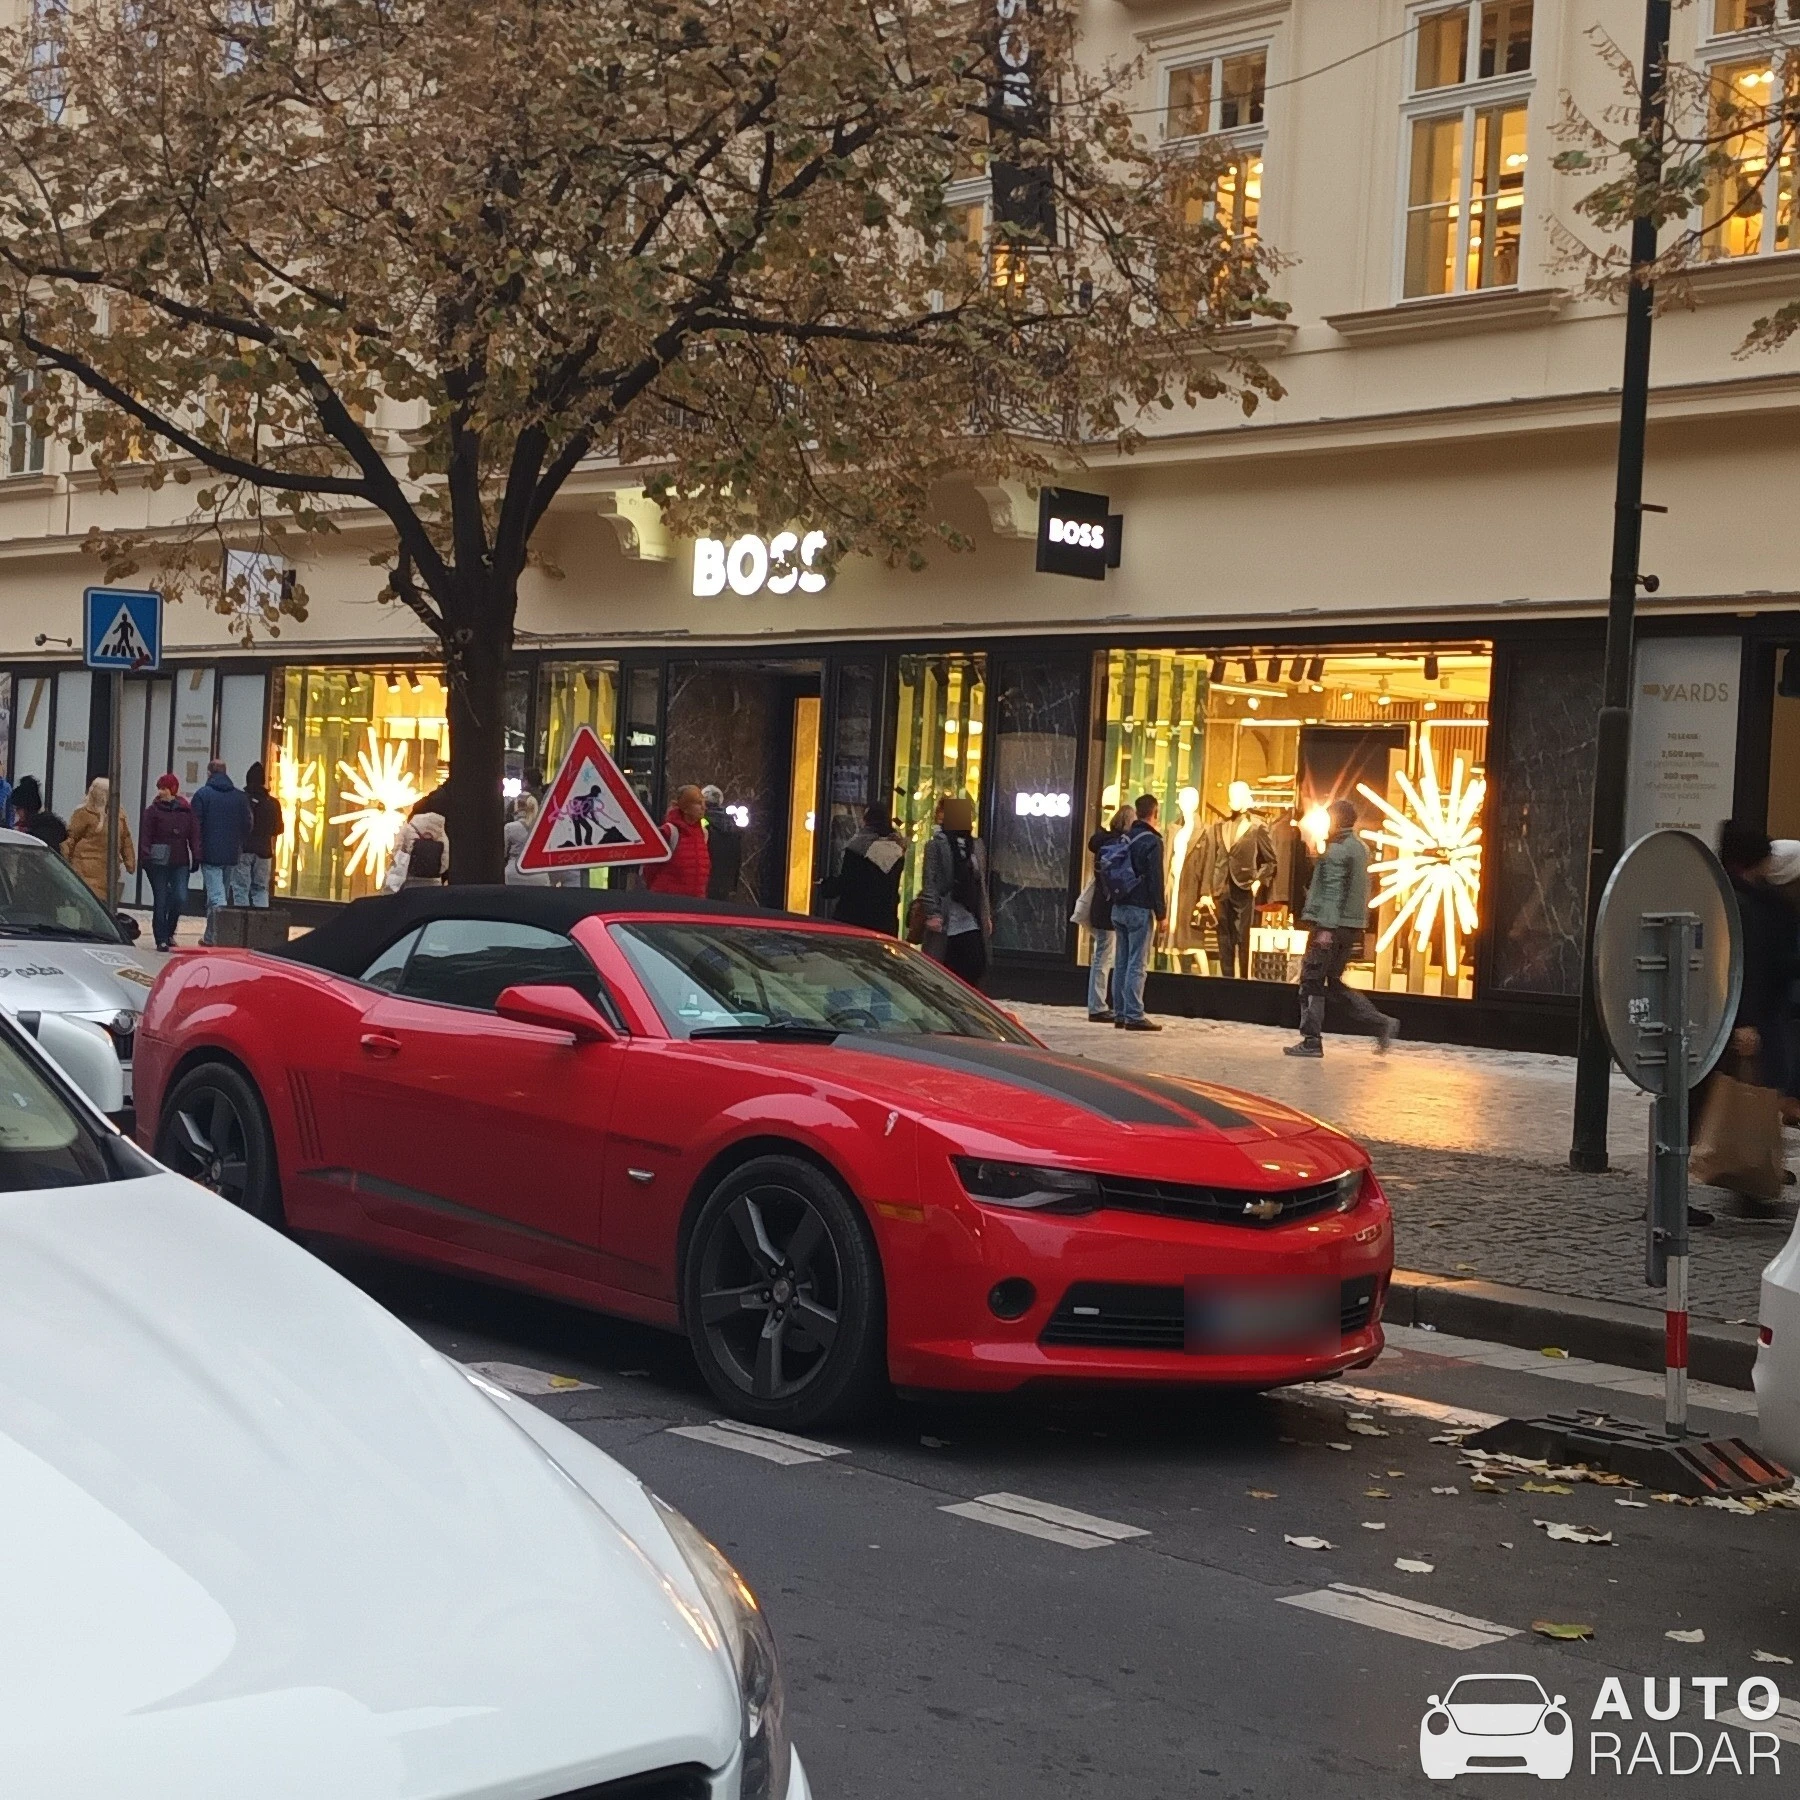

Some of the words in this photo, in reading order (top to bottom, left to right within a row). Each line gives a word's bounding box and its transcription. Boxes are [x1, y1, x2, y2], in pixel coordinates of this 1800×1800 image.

[1048, 517, 1105, 550] BOSS
[692, 529, 828, 597] BOSS
[1661, 682, 1729, 702] YARDS
[1015, 792, 1071, 818] BOSS
